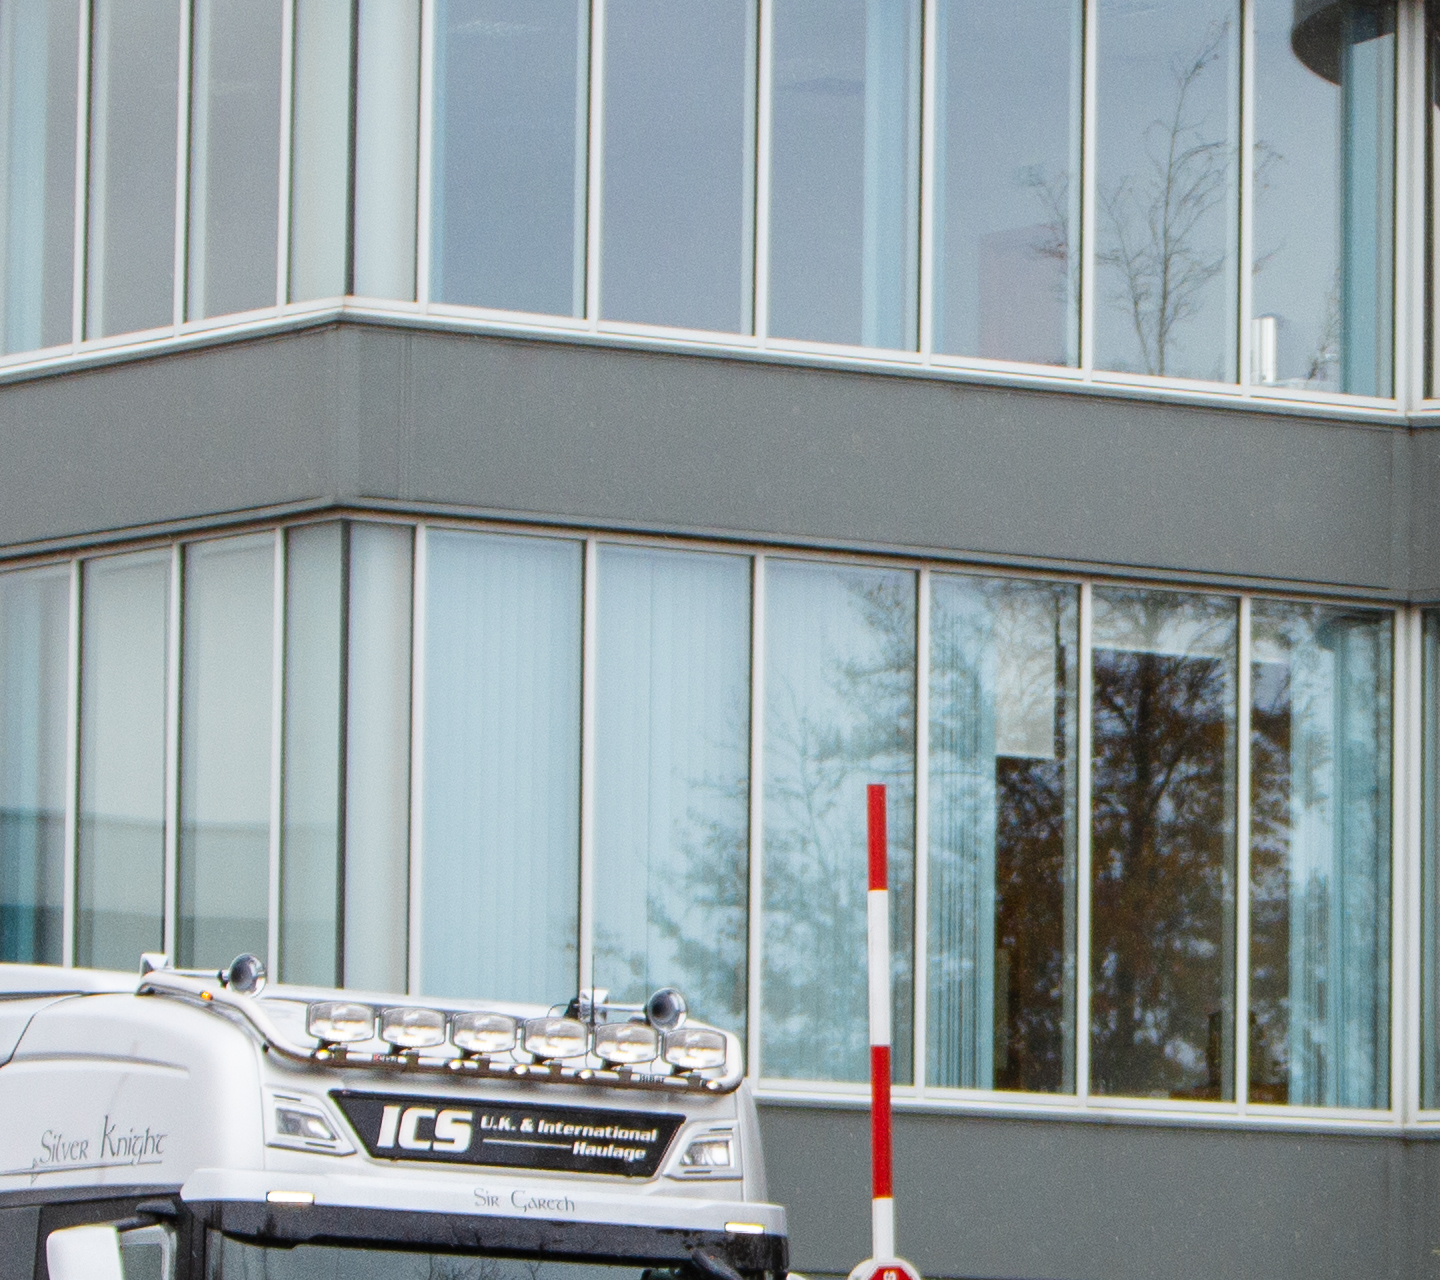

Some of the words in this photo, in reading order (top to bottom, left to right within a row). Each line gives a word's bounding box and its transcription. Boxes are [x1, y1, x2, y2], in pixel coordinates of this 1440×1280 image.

[39, 1129, 89, 1163] Silver
[100, 1114, 168, 1166] Knight
[376, 1105, 473, 1153] ICS
[480, 1115, 516, 1131] U.K.
[519, 1118, 535, 1133] &
[538, 1119, 658, 1142] International
[572, 1141, 647, 1161] Haulage
[474, 1187, 500, 1208] Sir
